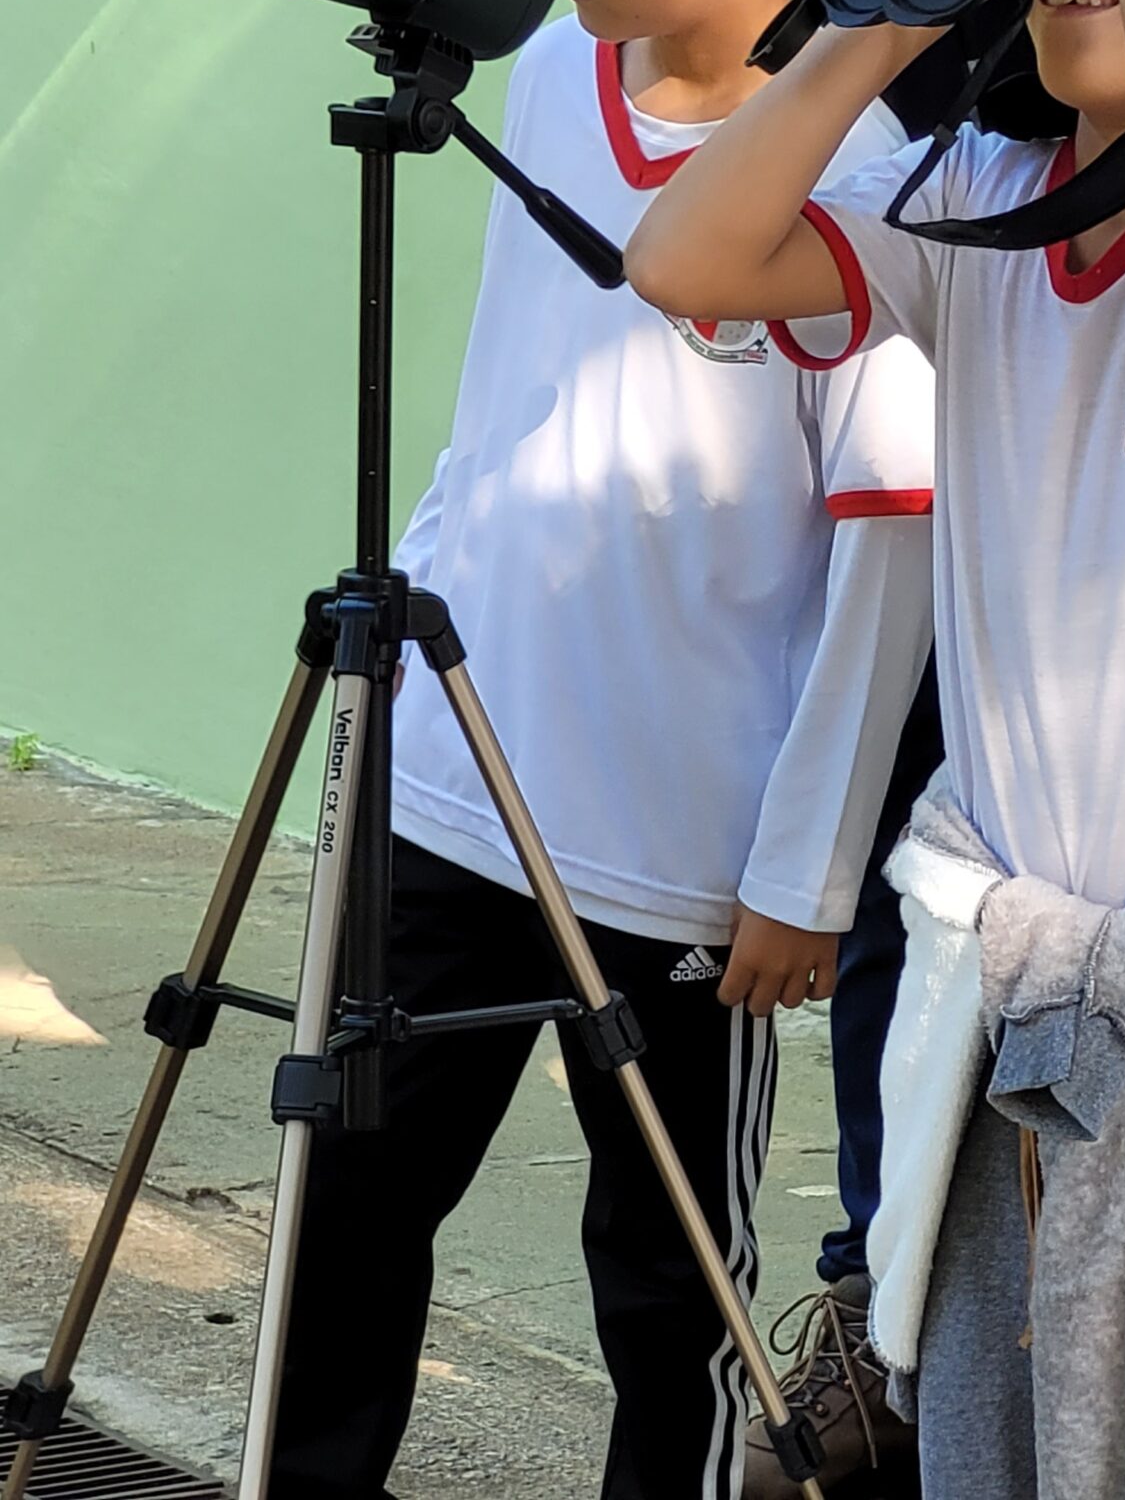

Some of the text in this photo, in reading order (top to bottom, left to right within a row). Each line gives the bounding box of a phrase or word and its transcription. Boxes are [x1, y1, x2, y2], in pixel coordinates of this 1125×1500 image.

[321, 708, 354, 854] Velbon CX 200
[669, 964, 723, 982] adidas
